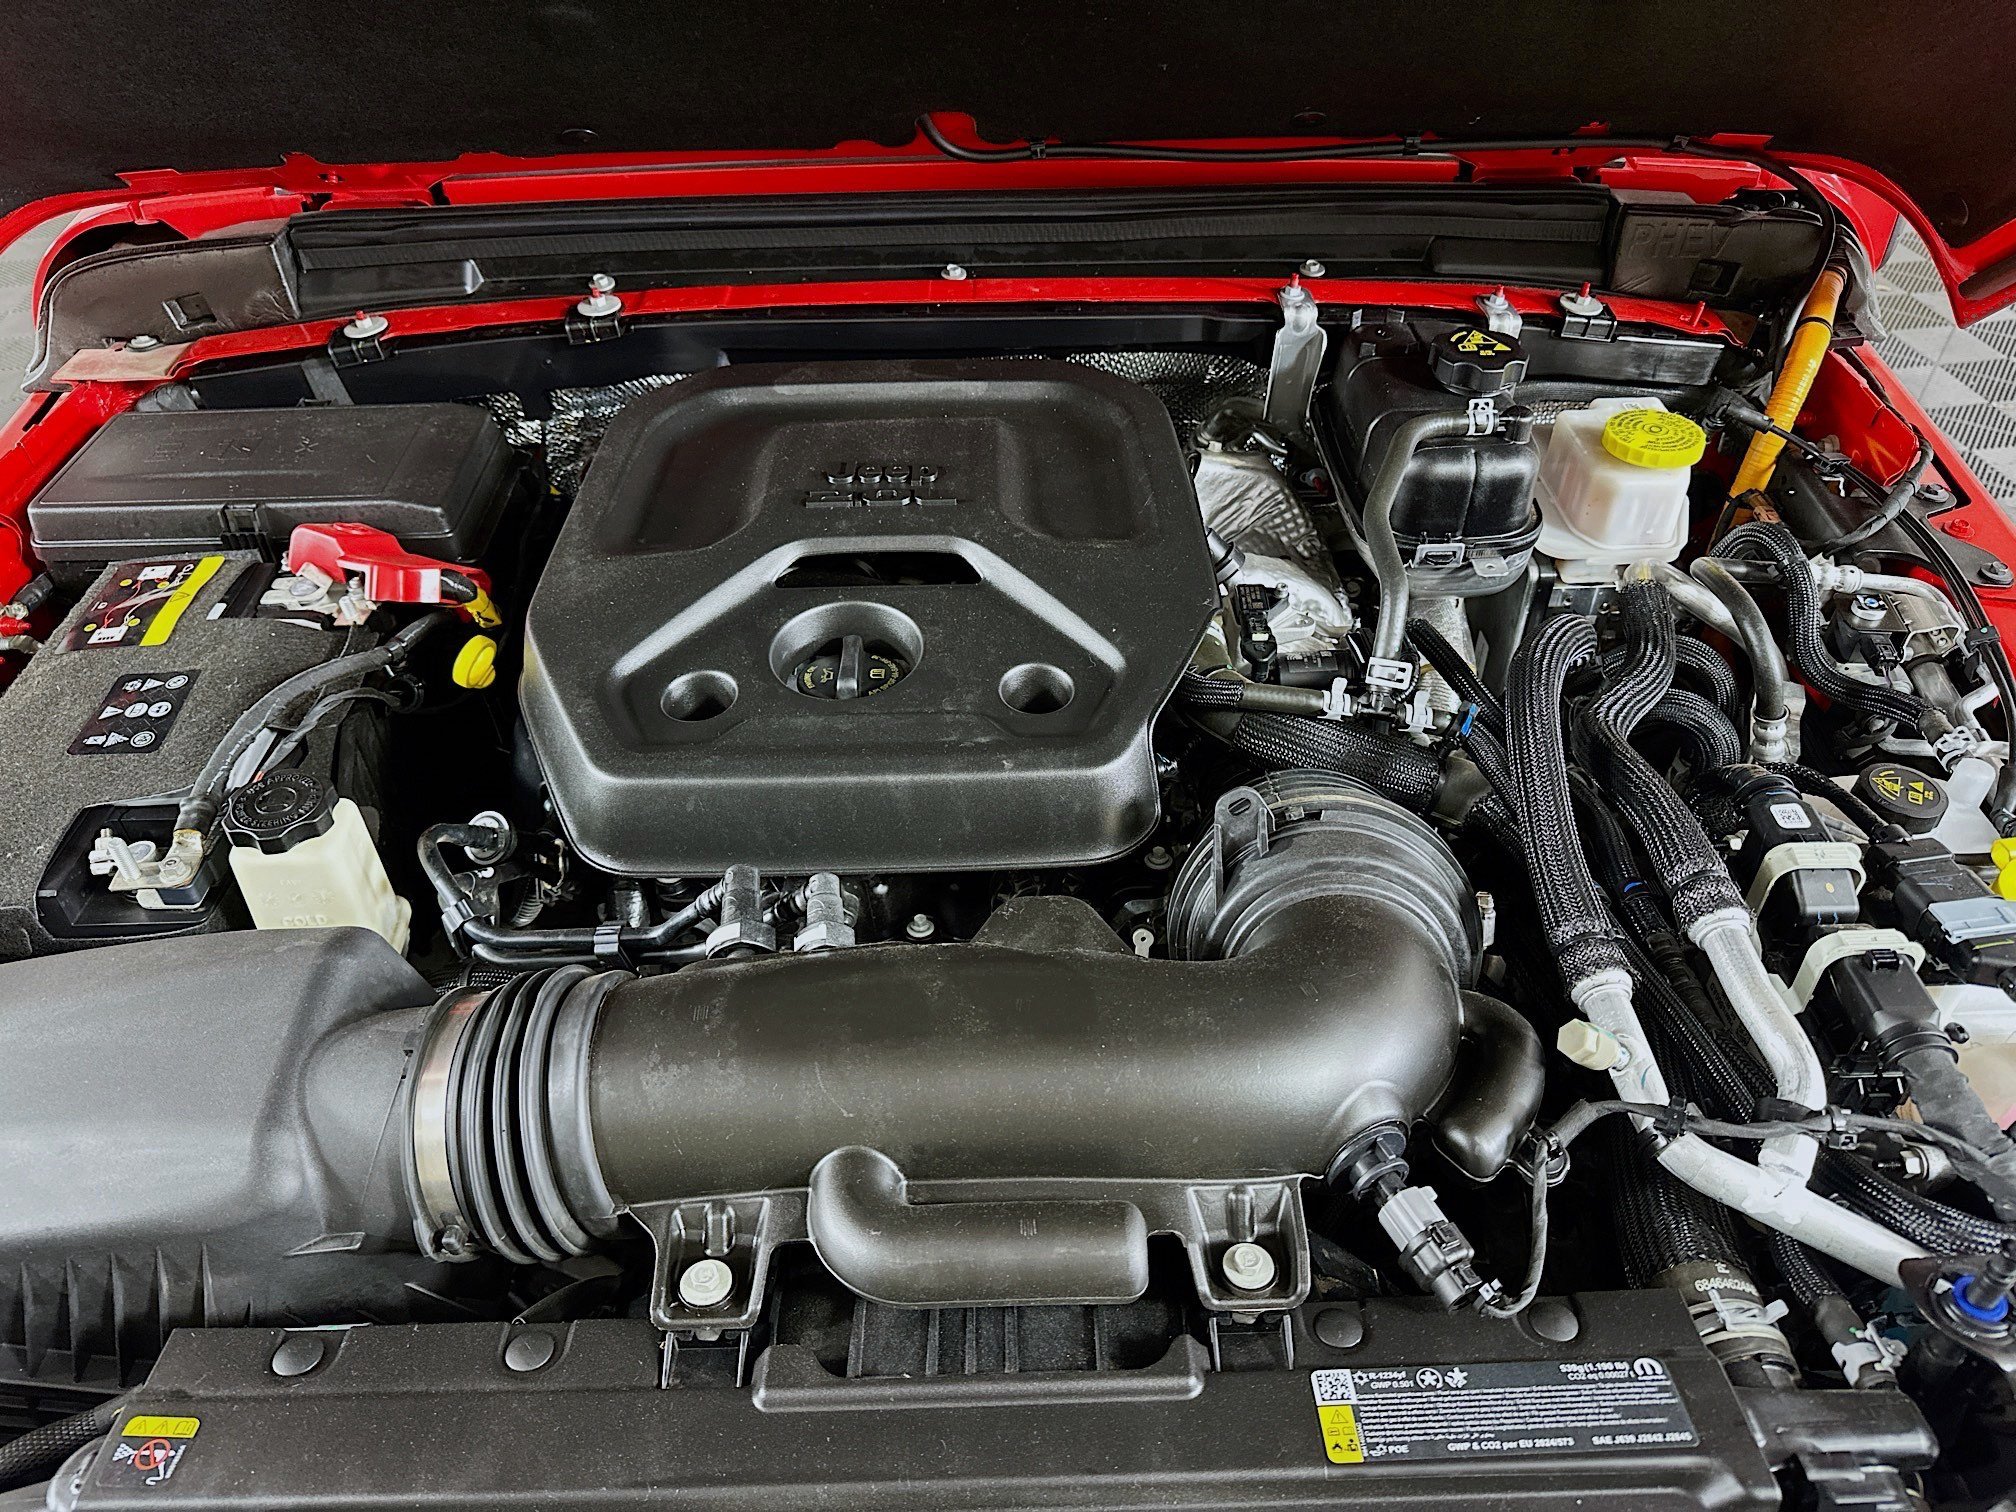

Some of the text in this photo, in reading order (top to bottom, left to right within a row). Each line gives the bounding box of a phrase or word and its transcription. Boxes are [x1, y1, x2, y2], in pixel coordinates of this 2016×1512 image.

[1628, 222, 1734, 259] PHEV
[822, 463, 939, 487] Jeep
[282, 914, 328, 926] COLD
[1567, 1372, 1587, 1381] CO2
[1370, 1379, 1415, 1390] GWP 0.501
[1447, 1441, 1472, 1452] GWP
[1480, 1440, 1502, 1450] CO2
[1518, 1438, 1534, 1449] EU
[1591, 1434, 1614, 1446] SAE
[1388, 1444, 1410, 1454] POE
